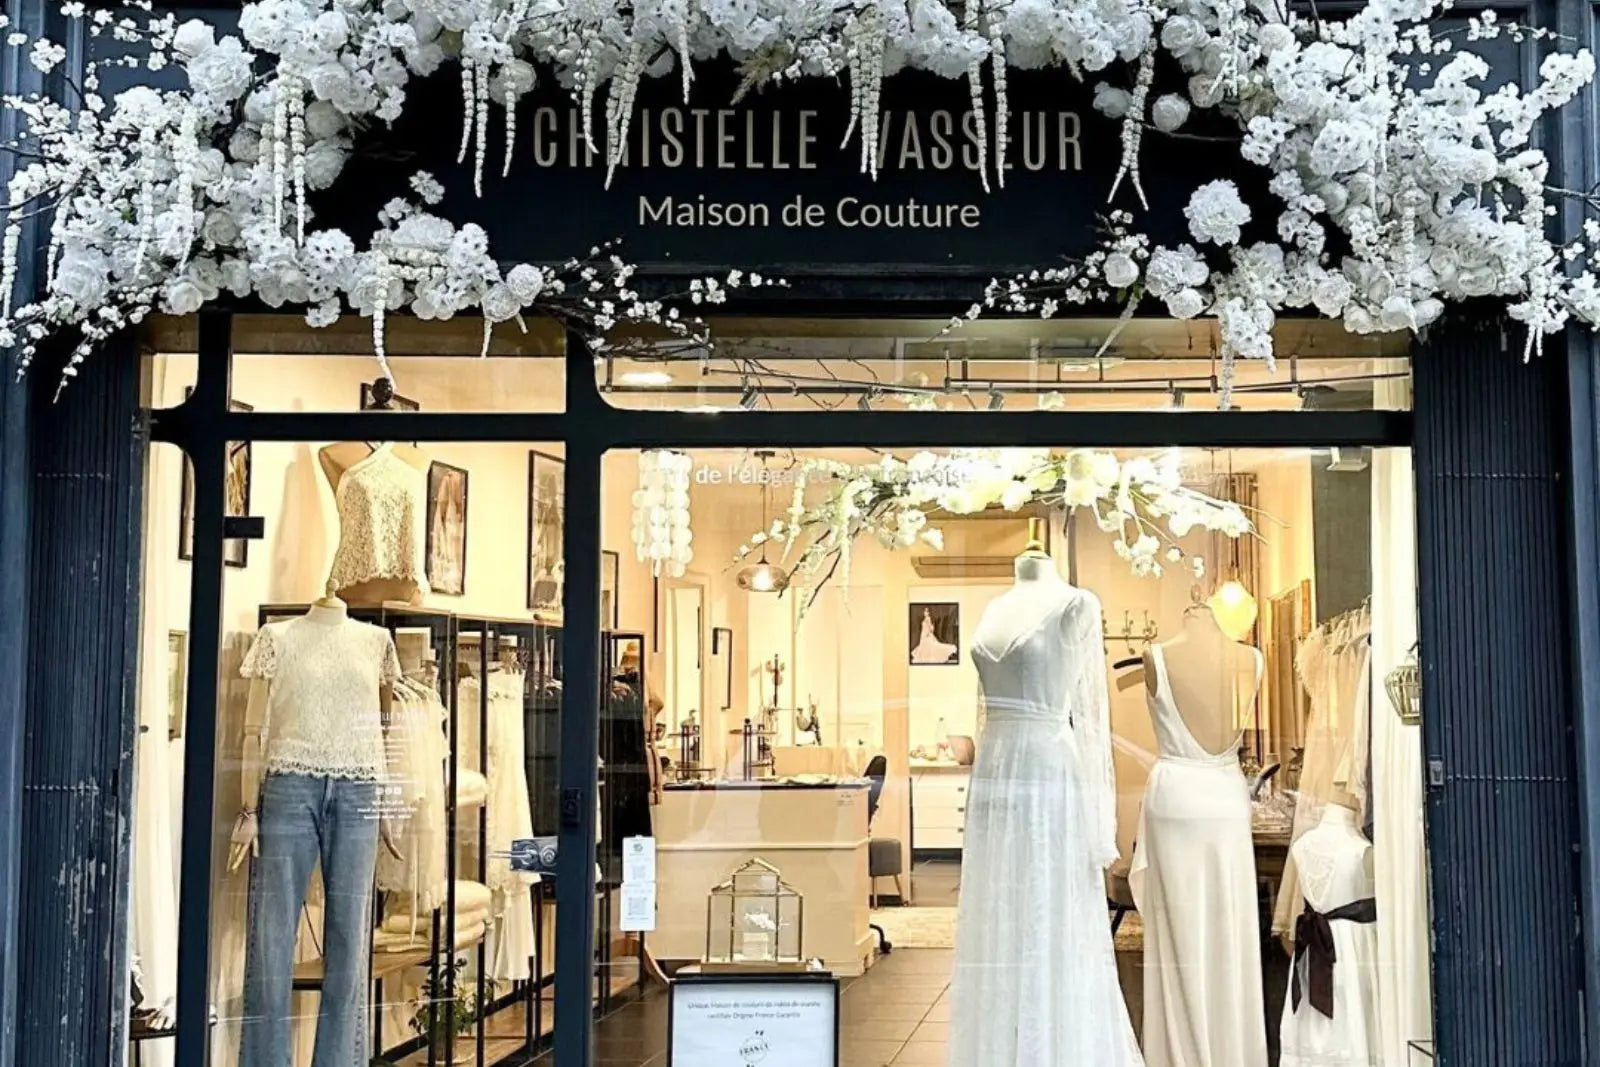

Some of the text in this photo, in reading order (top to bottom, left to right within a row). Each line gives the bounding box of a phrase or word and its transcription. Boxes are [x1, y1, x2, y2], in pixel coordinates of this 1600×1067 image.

[638, 194, 981, 228] Maison de Couture
[695, 464, 722, 484] de
